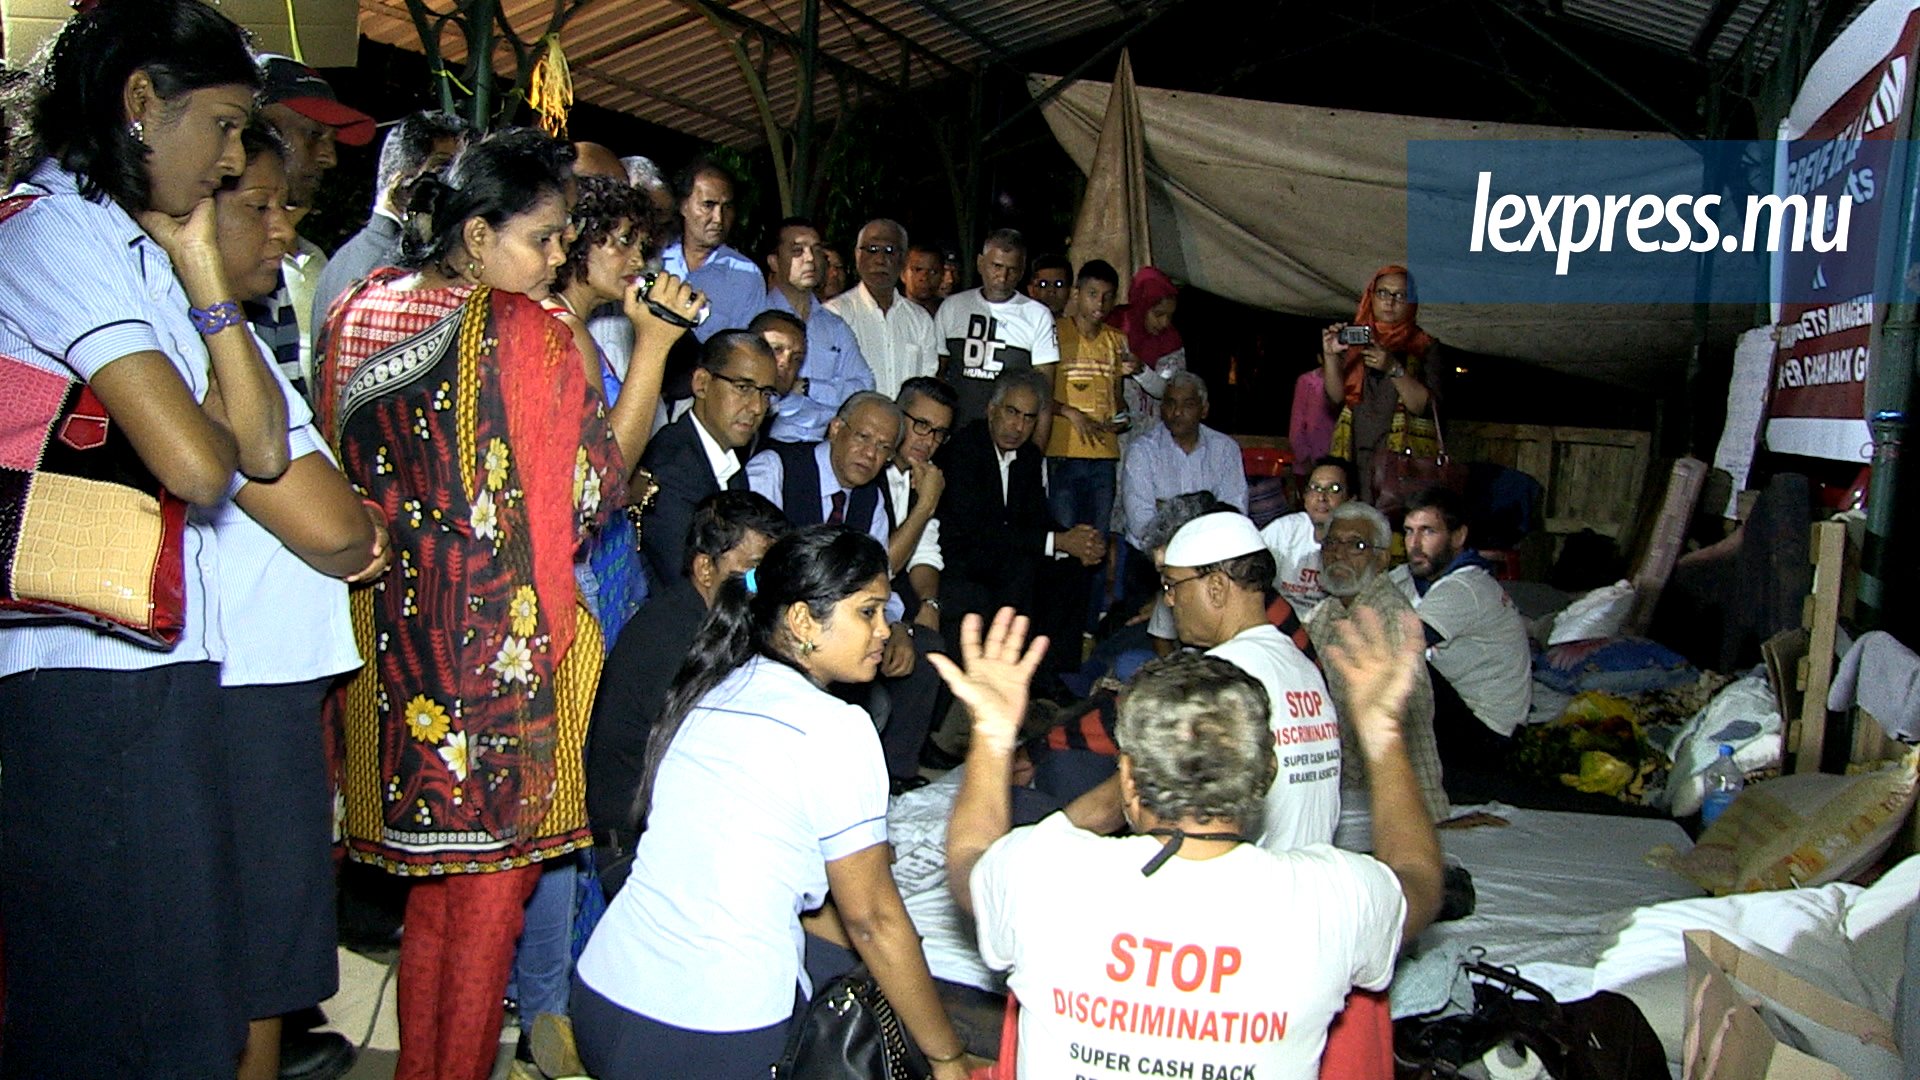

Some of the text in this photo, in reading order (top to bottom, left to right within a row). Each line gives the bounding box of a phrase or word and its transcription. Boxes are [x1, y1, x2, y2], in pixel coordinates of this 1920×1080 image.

[1285, 690, 1323, 718] STOP
[1283, 752, 1309, 768] SUPER
[1105, 932, 1242, 994] STOP
[1052, 987, 1288, 1044] DISCRIMINATION
[1069, 1042, 1257, 1080] SUPER CASH BACK
